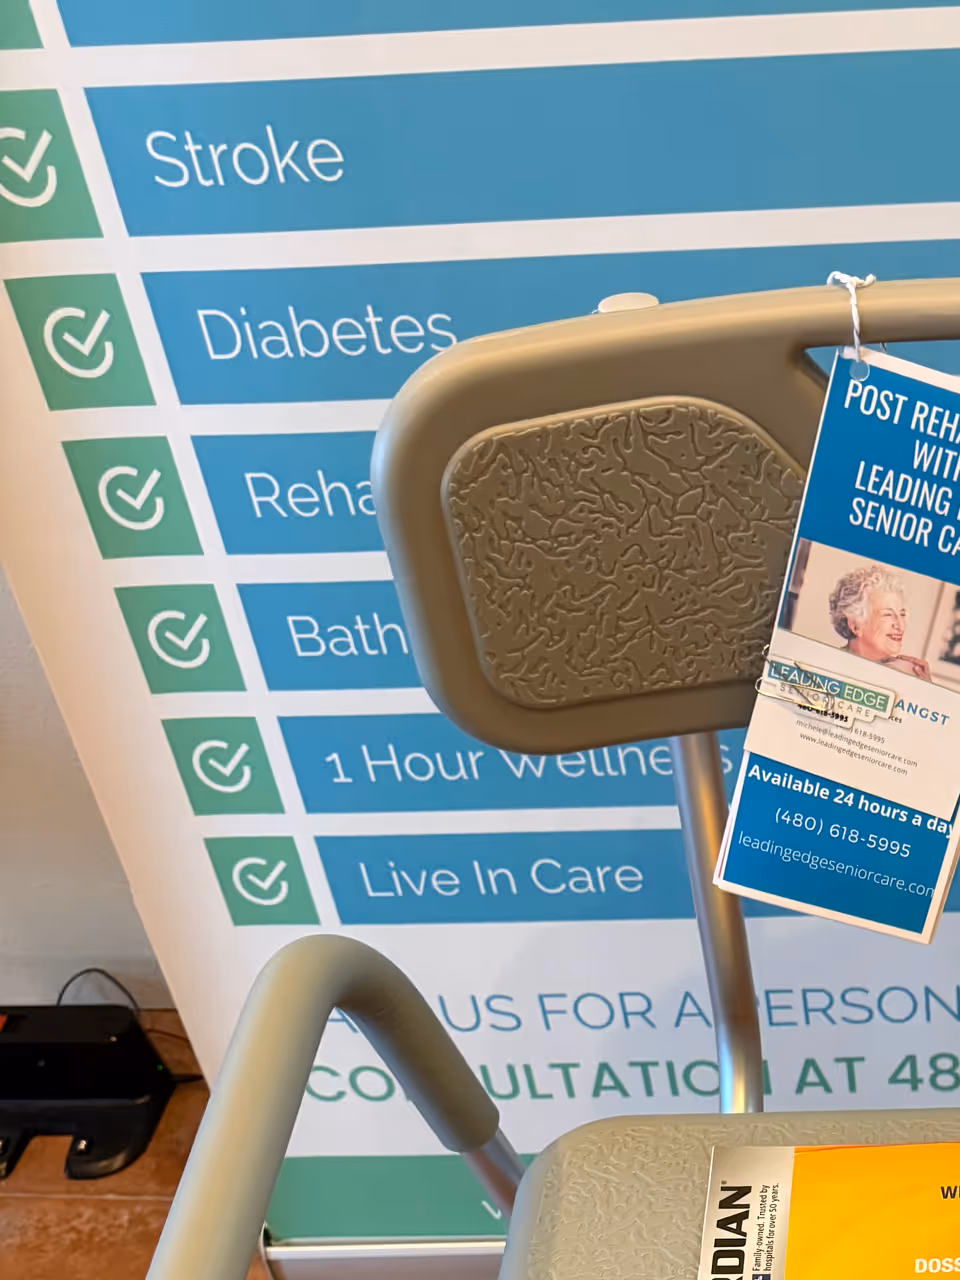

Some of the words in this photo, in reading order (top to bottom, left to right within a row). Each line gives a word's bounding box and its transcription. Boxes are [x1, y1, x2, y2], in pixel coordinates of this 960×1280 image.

[146, 124, 344, 187] Stroke
[197, 304, 458, 361] Diabetes
[844, 379, 908, 425] POST
[854, 460, 952, 516] LEADING
[849, 497, 933, 547] SENIOR
[286, 611, 409, 657] Bath
[838, 700, 871, 717] CARE
[844, 685, 888, 710] EDGE
[895, 698, 950, 725] ANGST
[325, 752, 353, 783] 1
[361, 743, 485, 783] Hour
[498, 744, 734, 779] Wellnes
[800, 732, 908, 775] www.leadingedgeseniorcare.com
[748, 764, 830, 799] Available
[833, 788, 854, 807] 24
[858, 798, 908, 823] hours
[911, 812, 922, 827] a
[926, 815, 954, 839] day
[775, 807, 824, 834] (480)
[829, 823, 911, 857] 618-5995
[358, 860, 461, 898] Live
[473, 860, 518, 897] In
[530, 857, 643, 894] Care
[438, 993, 523, 1033] US
[538, 991, 657, 1031] FOR
[674, 990, 712, 1028] A
[305, 1058, 772, 1102] COULTATIO
[795, 1056, 865, 1095] AT
[757, 1194, 767, 1220] Trusted
[759, 1184, 770, 1194] by
[769, 1203, 777, 1213] 50
[771, 1183, 780, 1203] years.
[766, 1230, 775, 1240] for
[768, 1213, 777, 1229] over
[752, 1222, 766, 1272] Family-owned.
[763, 1240, 775, 1272] hospitals
